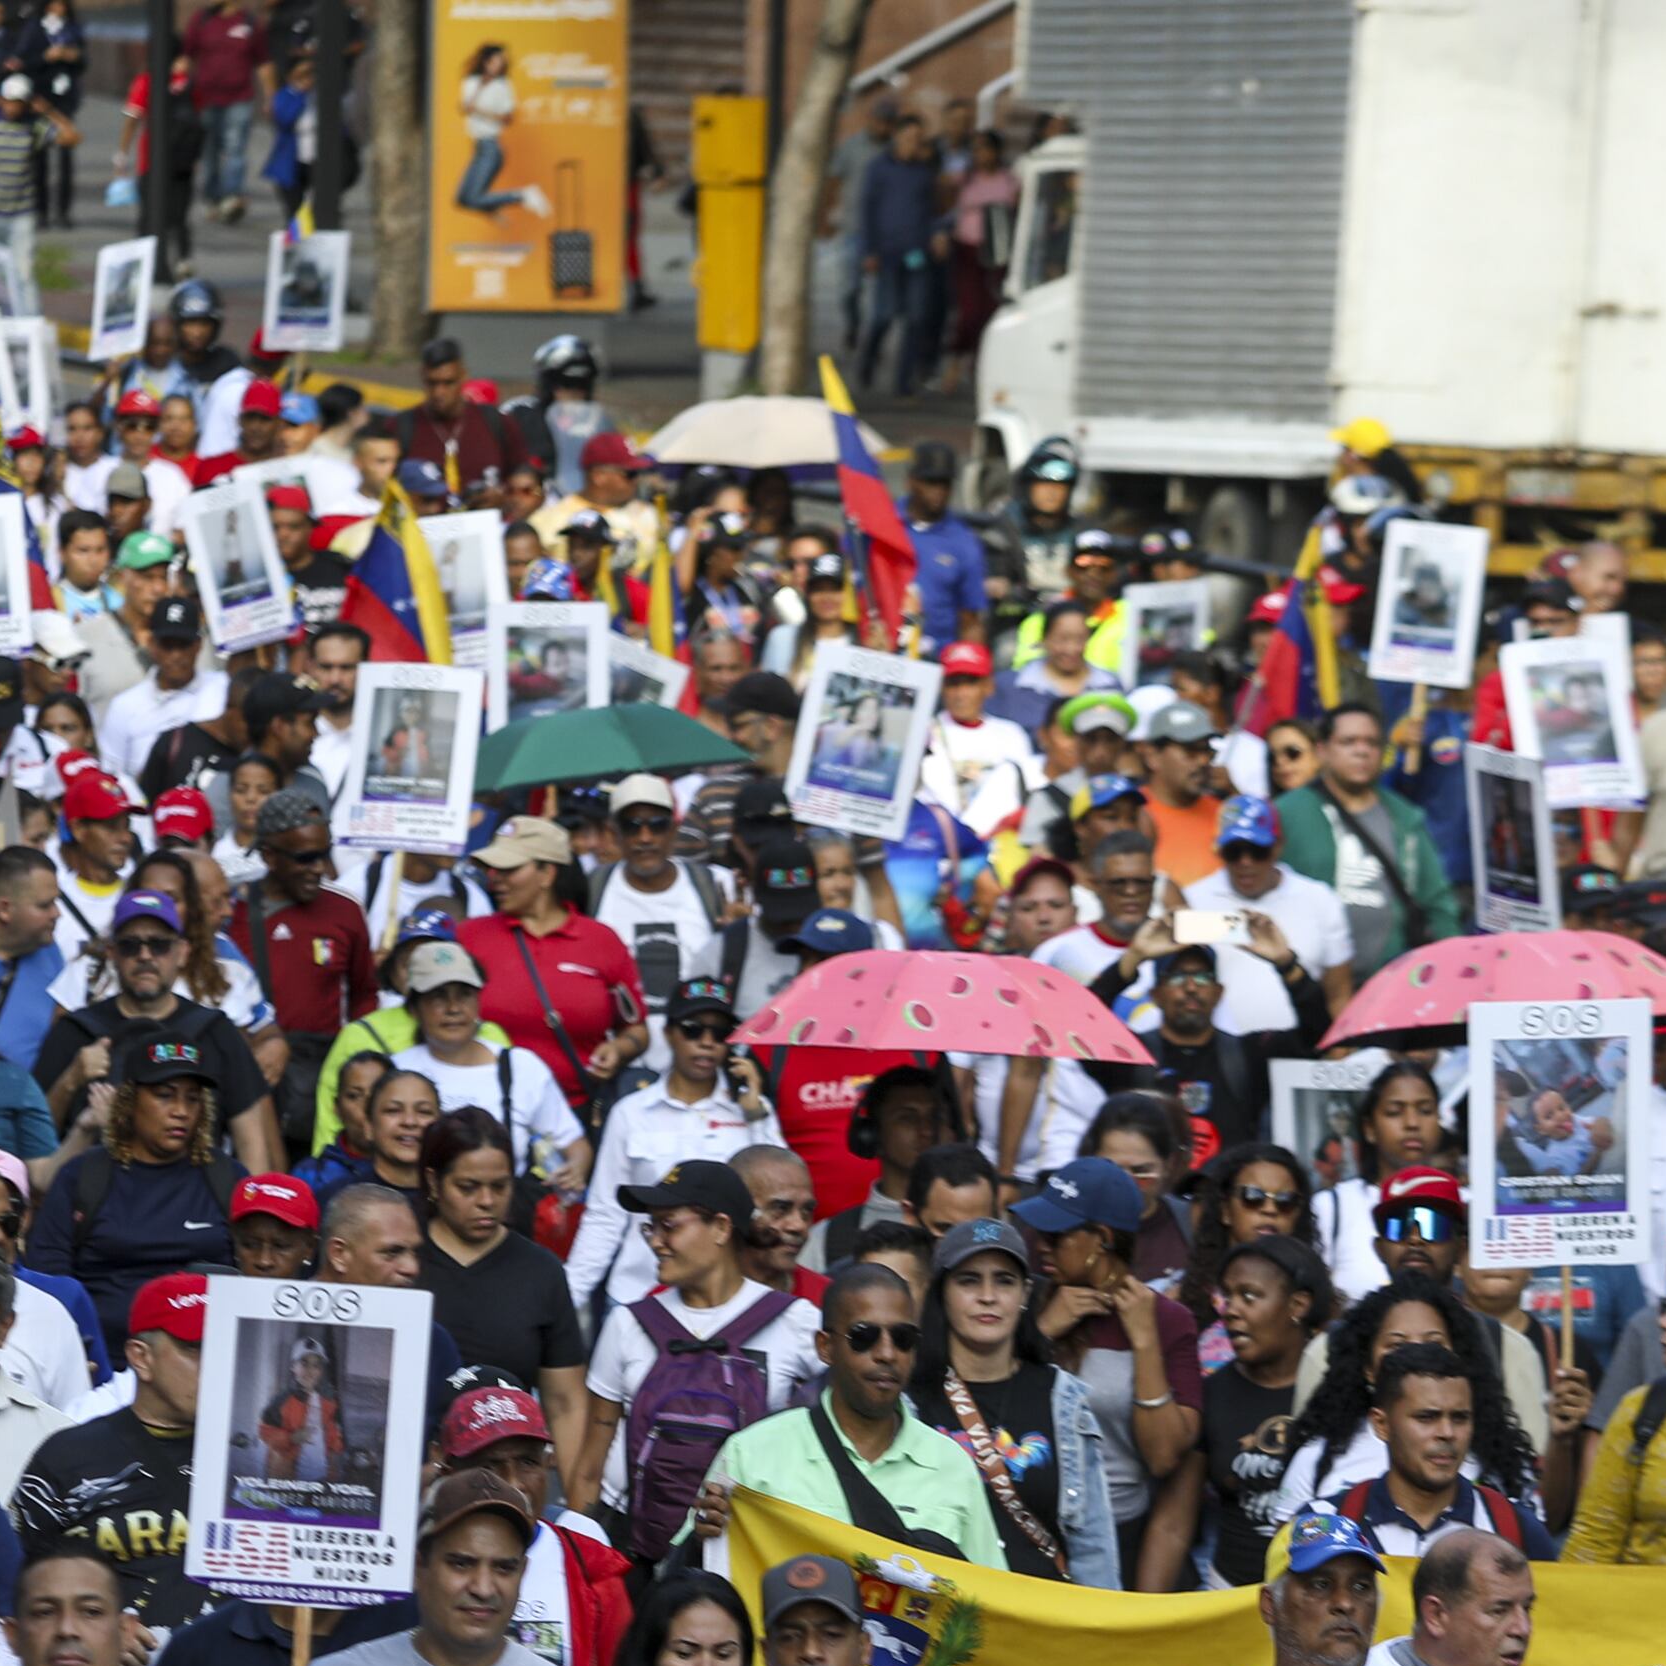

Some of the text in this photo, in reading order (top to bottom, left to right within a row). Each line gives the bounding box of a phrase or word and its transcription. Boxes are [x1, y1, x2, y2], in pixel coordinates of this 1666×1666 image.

[1519, 1004, 1600, 1036] SOS
[1484, 1217, 1555, 1258] USA
[272, 1283, 362, 1320] SOS
[203, 1520, 291, 1578] USA
[293, 1530, 397, 1550] LIBEREN A
[292, 1546, 393, 1568] NUESTROS
[313, 1564, 371, 1584] HIJOS
[210, 1582, 385, 1606] #FREEOURCHILDREN
